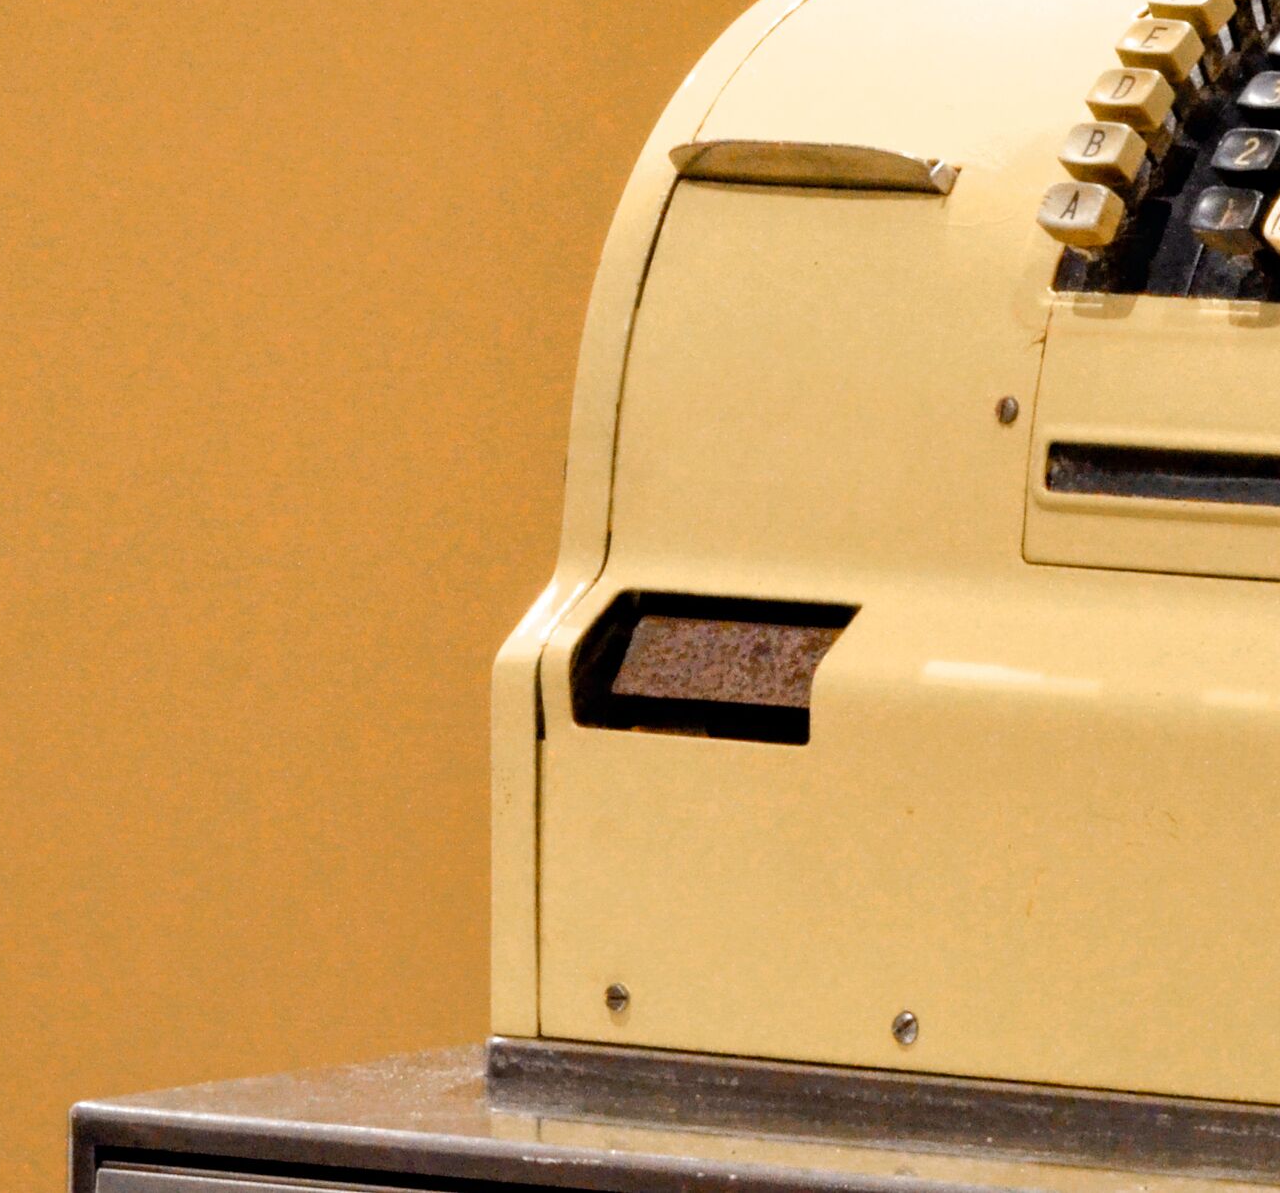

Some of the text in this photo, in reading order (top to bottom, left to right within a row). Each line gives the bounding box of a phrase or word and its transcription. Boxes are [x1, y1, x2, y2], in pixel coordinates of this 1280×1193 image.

[1141, 26, 1169, 49] E
[1111, 75, 1136, 100] D
[1082, 129, 1107, 158] B
[1234, 137, 1261, 166] 2
[1060, 190, 1081, 220] A
